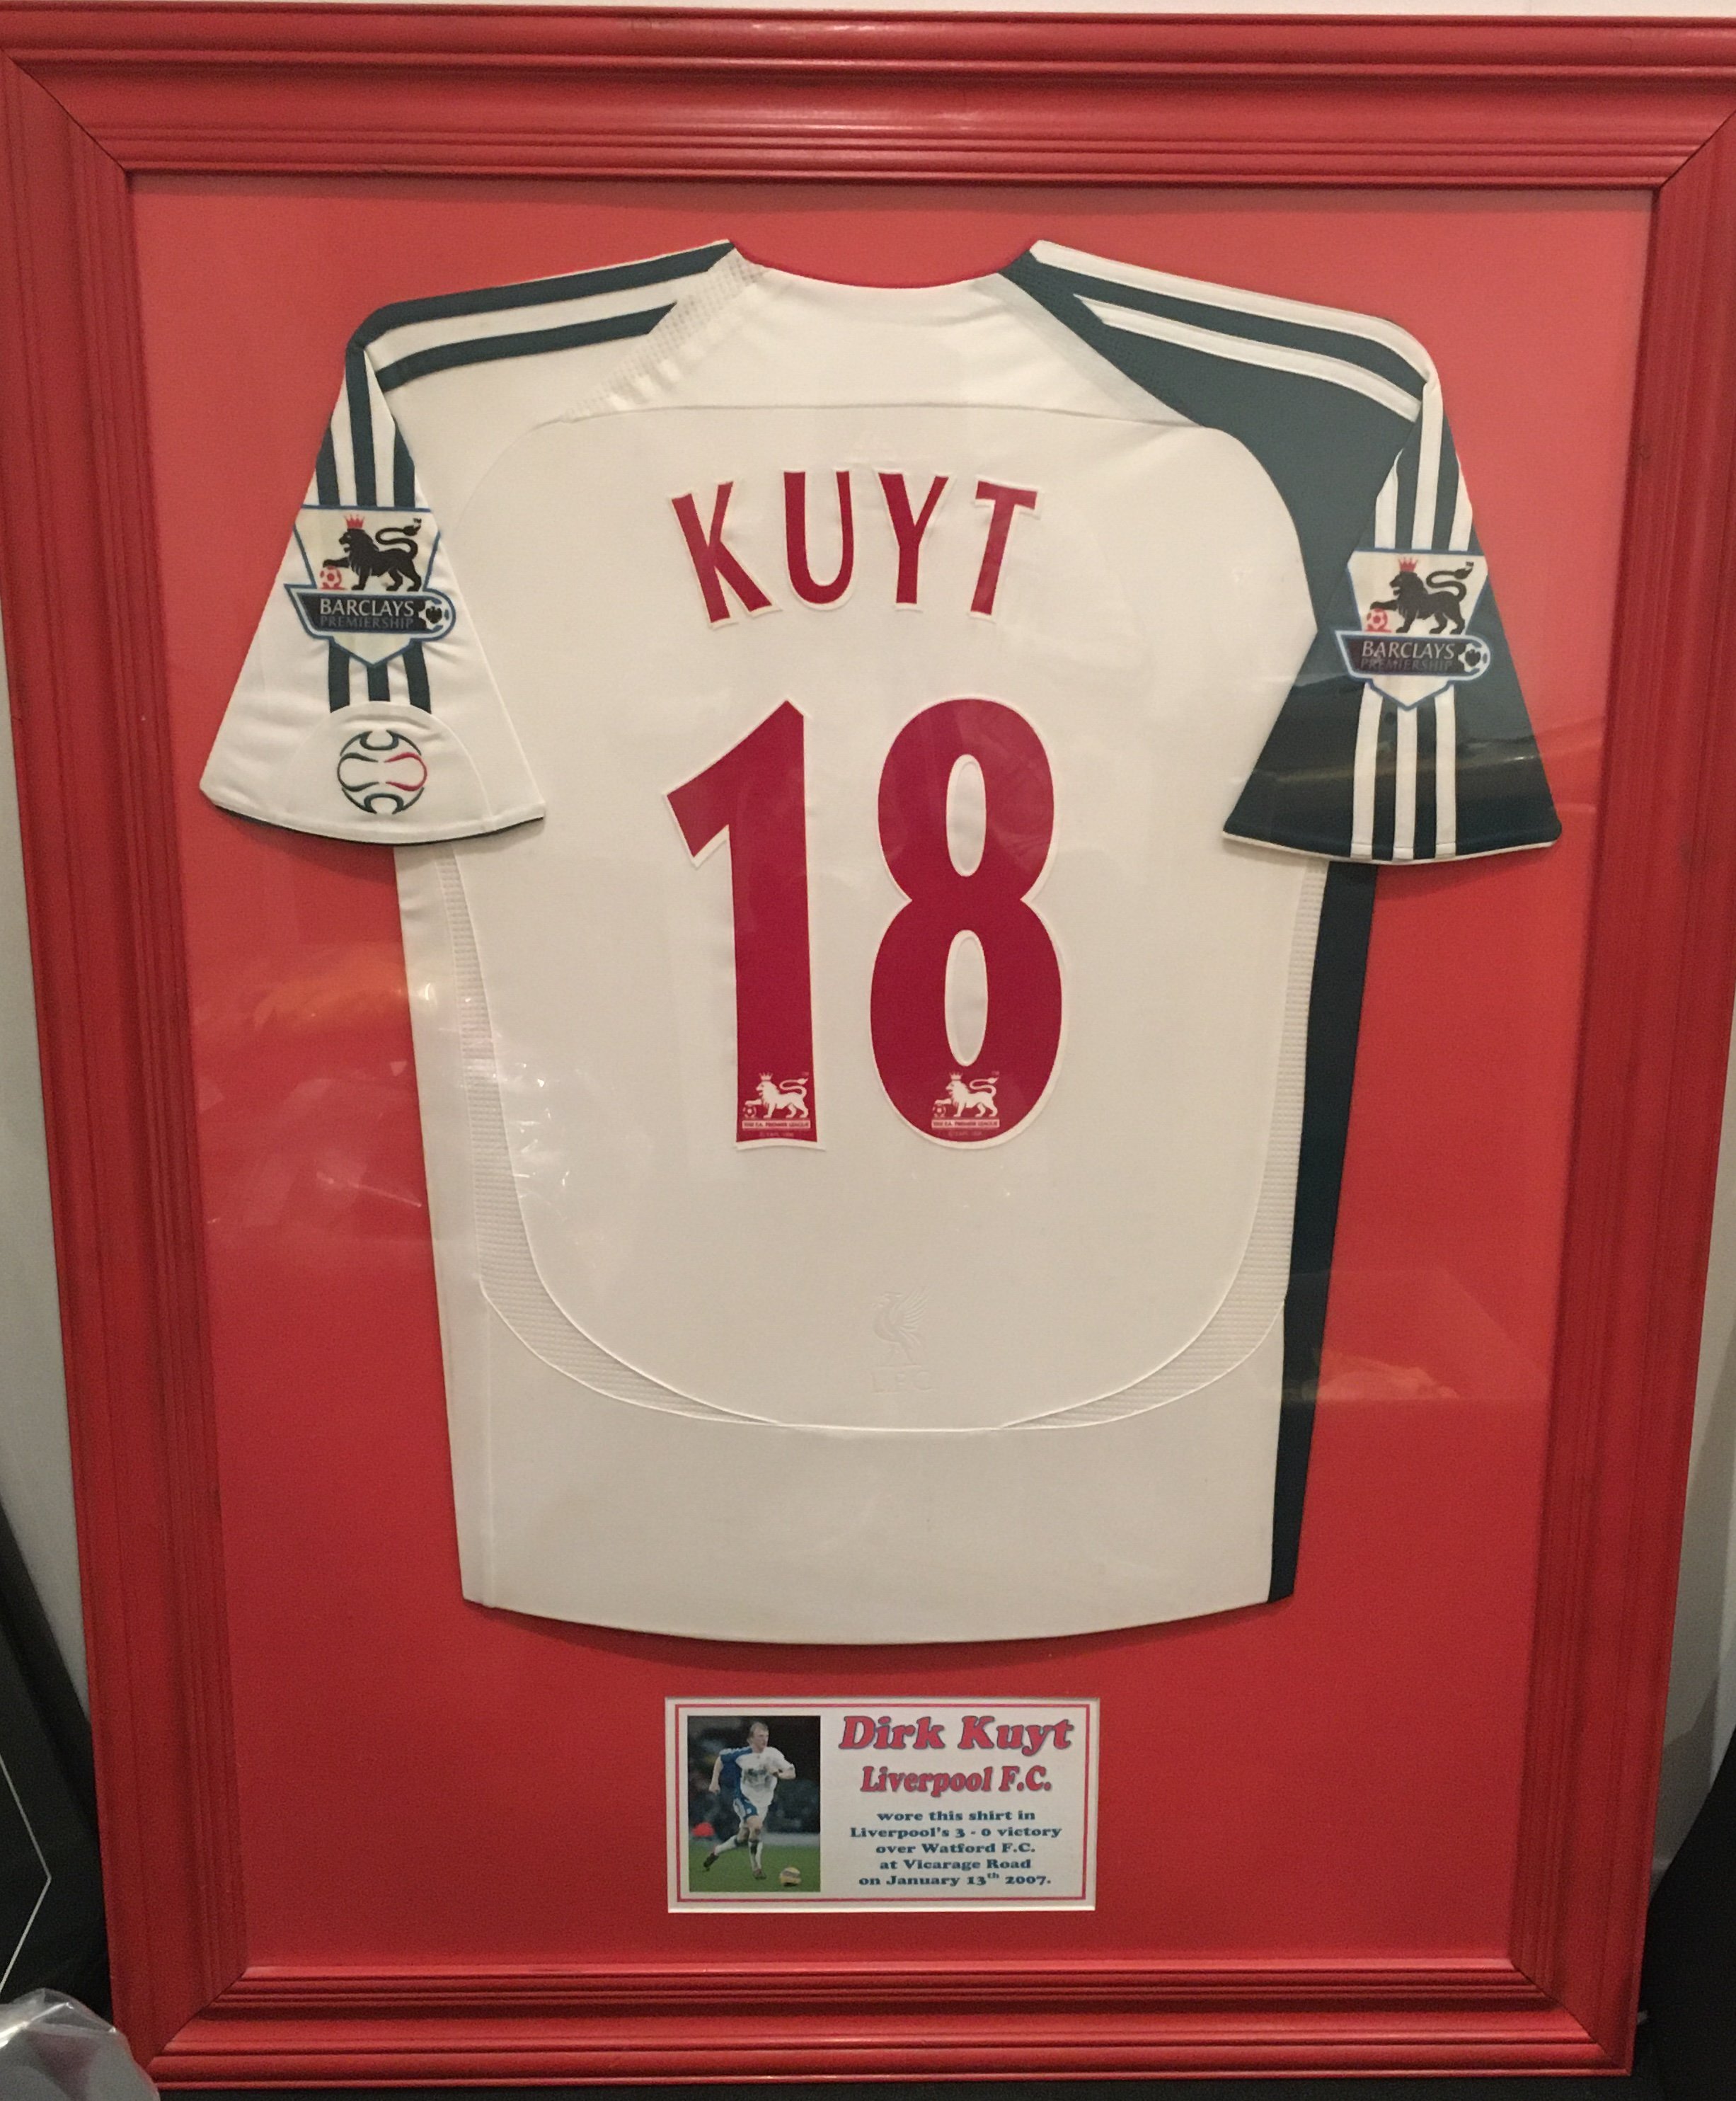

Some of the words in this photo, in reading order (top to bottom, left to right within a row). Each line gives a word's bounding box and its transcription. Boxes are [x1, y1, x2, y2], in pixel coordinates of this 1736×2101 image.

[671, 471, 1038, 624] KUYT
[320, 598, 415, 617] BARCLAYS
[320, 615, 414, 629] PREMIERSHIP
[1362, 641, 1456, 660] BARCLAYS
[666, 697, 1062, 1143] 18
[839, 1715, 945, 1749] Dirk
[958, 1715, 1074, 1756] Kuyt
[860, 1766, 994, 1797] Liverpool
[998, 1765, 1052, 1792] F.C.
[929, 1811, 962, 1821] this
[969, 1810, 1012, 1821] shirt
[1018, 1810, 1035, 1820] in
[851, 1827, 949, 1839] Liverpool's
[955, 1828, 965, 1838] 3
[981, 1828, 991, 1836] 0
[997, 1826, 1062, 1838] victory
[921, 1843, 996, 1853] Watford
[1002, 1843, 1035, 1853] F.C.
[880, 1860, 897, 1870] at
[903, 1860, 981, 1871] Vicarage
[987, 1859, 1031, 1869] Road
[886, 1874, 960, 1887] January
[1005, 1875, 1051, 1886] 2007.
